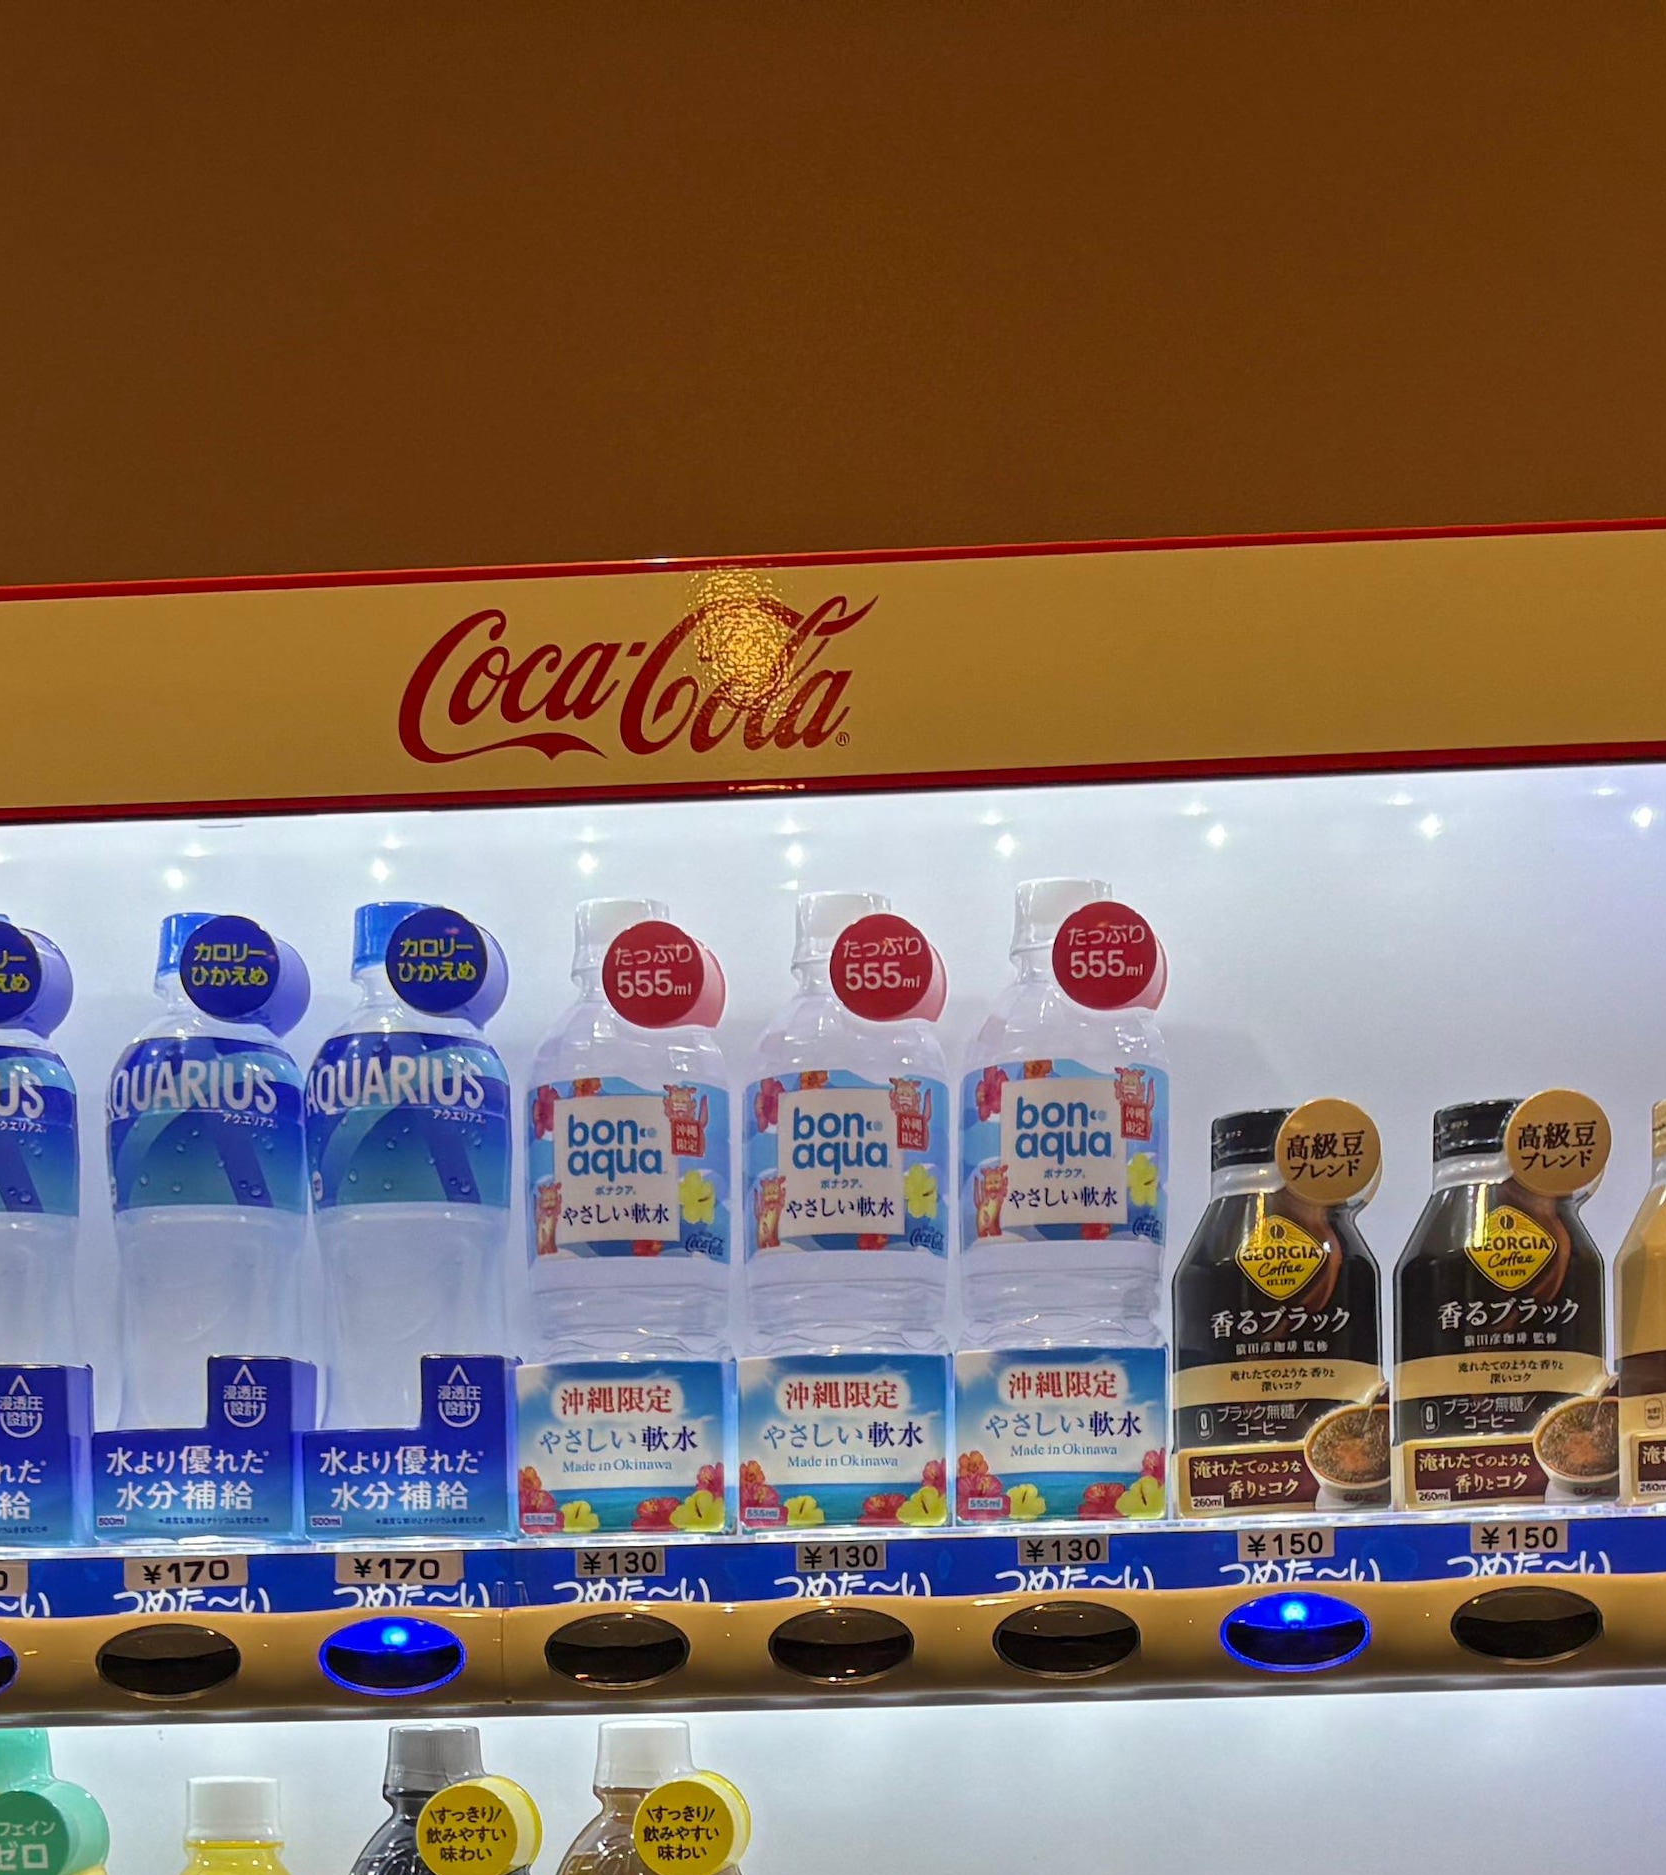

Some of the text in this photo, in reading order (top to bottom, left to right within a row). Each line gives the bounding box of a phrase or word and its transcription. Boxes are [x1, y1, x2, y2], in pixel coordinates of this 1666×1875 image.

[398, 595, 879, 764] Coca-Cola
[613, 943, 693, 966] たっぷり
[617, 969, 692, 998] 555ml
[567, 1114, 637, 1147] bon
[1286, 1131, 1365, 1160] 高級豆
[567, 1144, 663, 1182] aqua
[562, 1202, 670, 1227] やさしい軟水
[1244, 1244, 1324, 1261] GEORGIA
[1258, 1259, 1305, 1278] Coffee
[1210, 1306, 1352, 1336] 香るブラック
[438, 1384, 482, 1402] 浸透圧
[561, 1385, 673, 1415] 沖縄限定
[562, 1459, 672, 1472] Made in Okinawa
[1193, 1461, 1301, 1481] 淹れたてのような
[1247, 1532, 1324, 1555] ¥150
[1481, 1526, 1559, 1549] ¥150
[582, 1551, 657, 1574] ¥130
[805, 1545, 880, 1569] ¥130
[426, 1825, 507, 1845] 飲みやすい
[439, 1843, 493, 1863] 味わい
